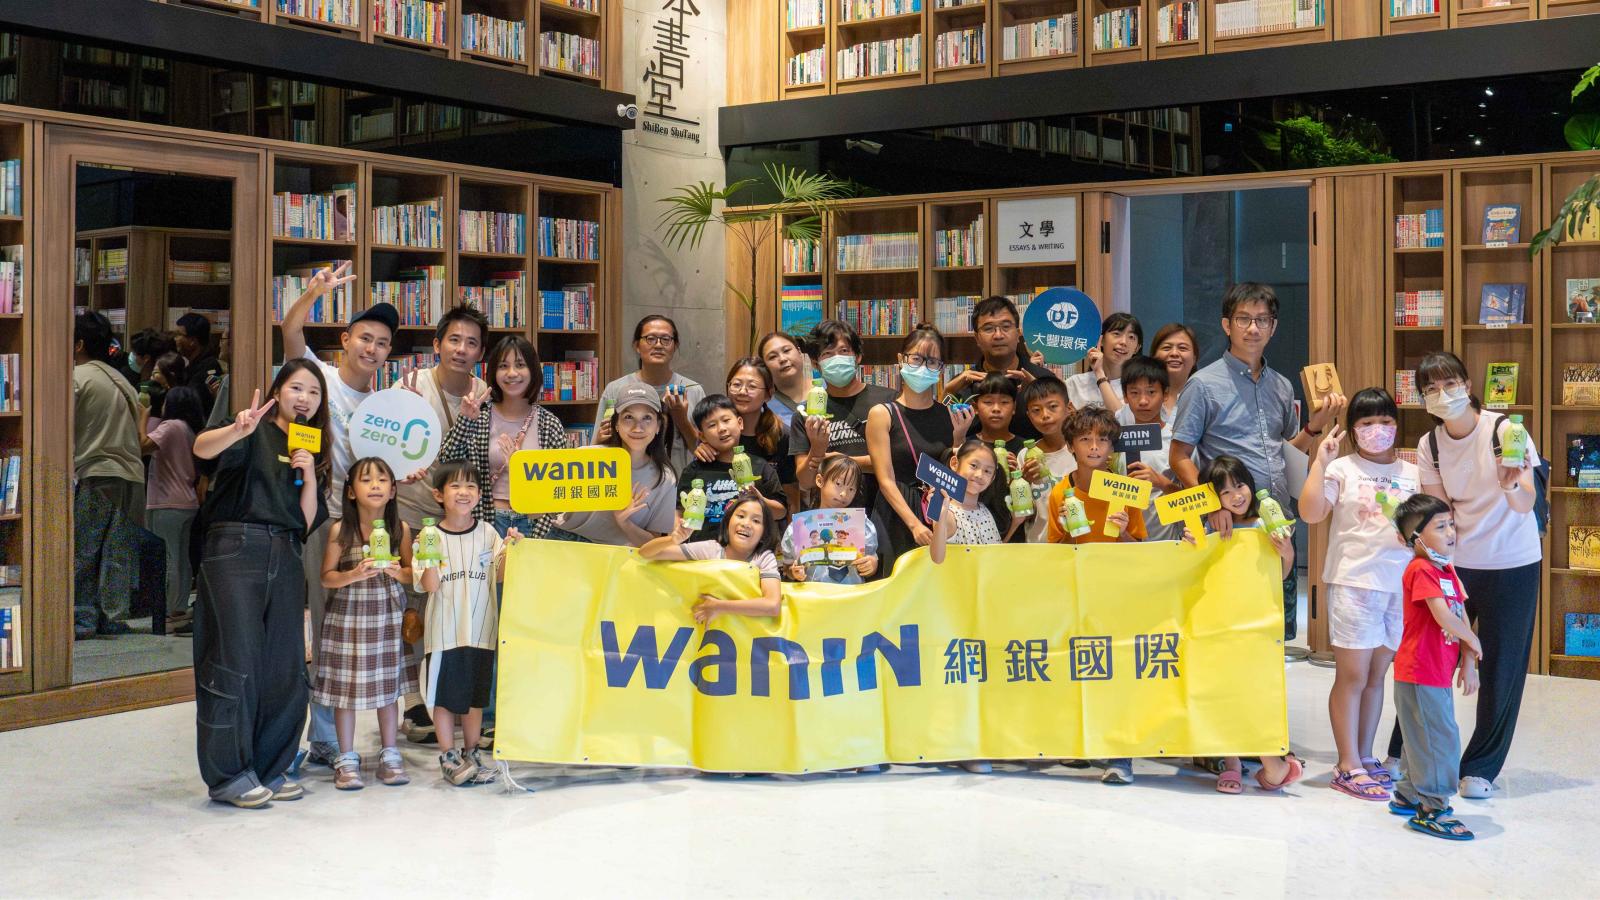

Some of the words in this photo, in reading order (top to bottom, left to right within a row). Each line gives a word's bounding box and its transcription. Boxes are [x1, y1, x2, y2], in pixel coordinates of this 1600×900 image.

[642, 121, 669, 135] ShiBen
[671, 127, 700, 144] ShuTang
[1019, 221, 1055, 238] 文學
[364, 413, 401, 432] zero
[360, 428, 398, 446] zero
[553, 484, 618, 499] 網銀國際
[943, 632, 1181, 684] 網銀國際
